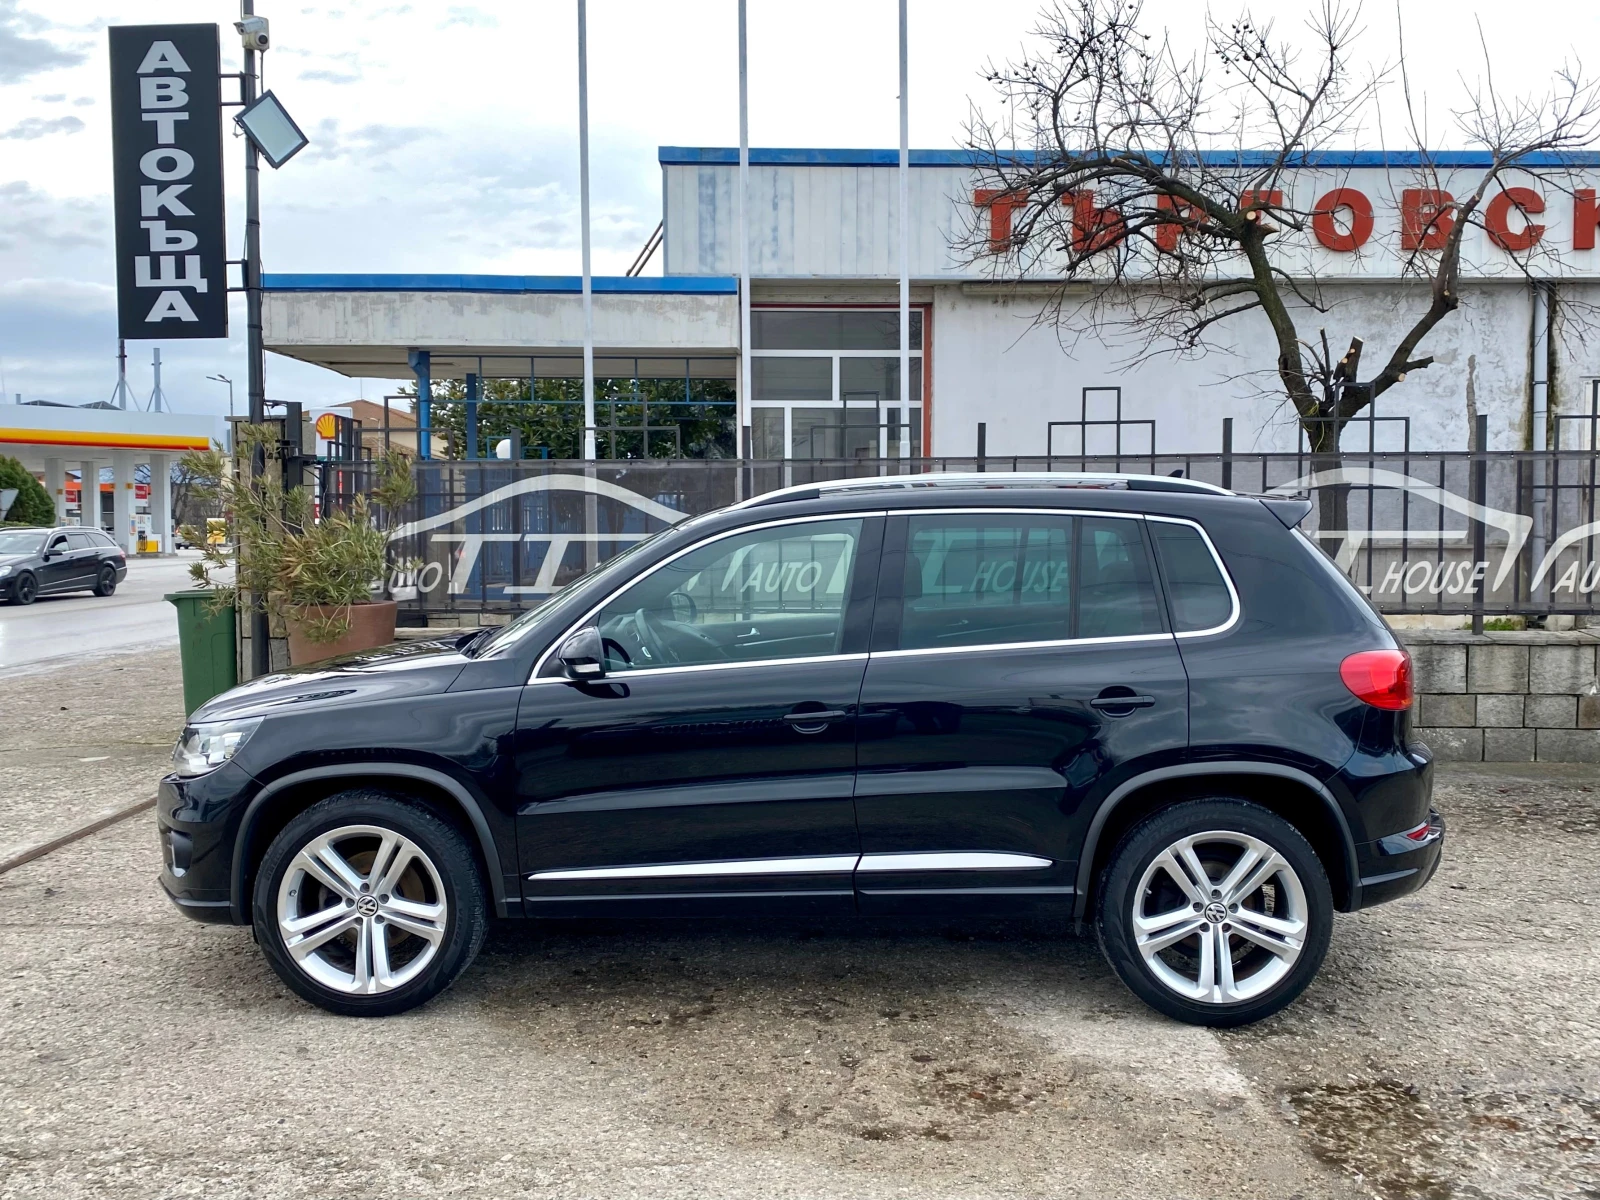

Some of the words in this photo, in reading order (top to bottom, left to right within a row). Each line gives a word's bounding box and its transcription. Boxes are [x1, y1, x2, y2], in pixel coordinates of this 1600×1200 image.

[135, 40, 208, 323] АВТОКЪЩА
[739, 561, 823, 594] AUTO
[968, 560, 1069, 593] HOUSE
[1378, 560, 1490, 595] HOUSE
